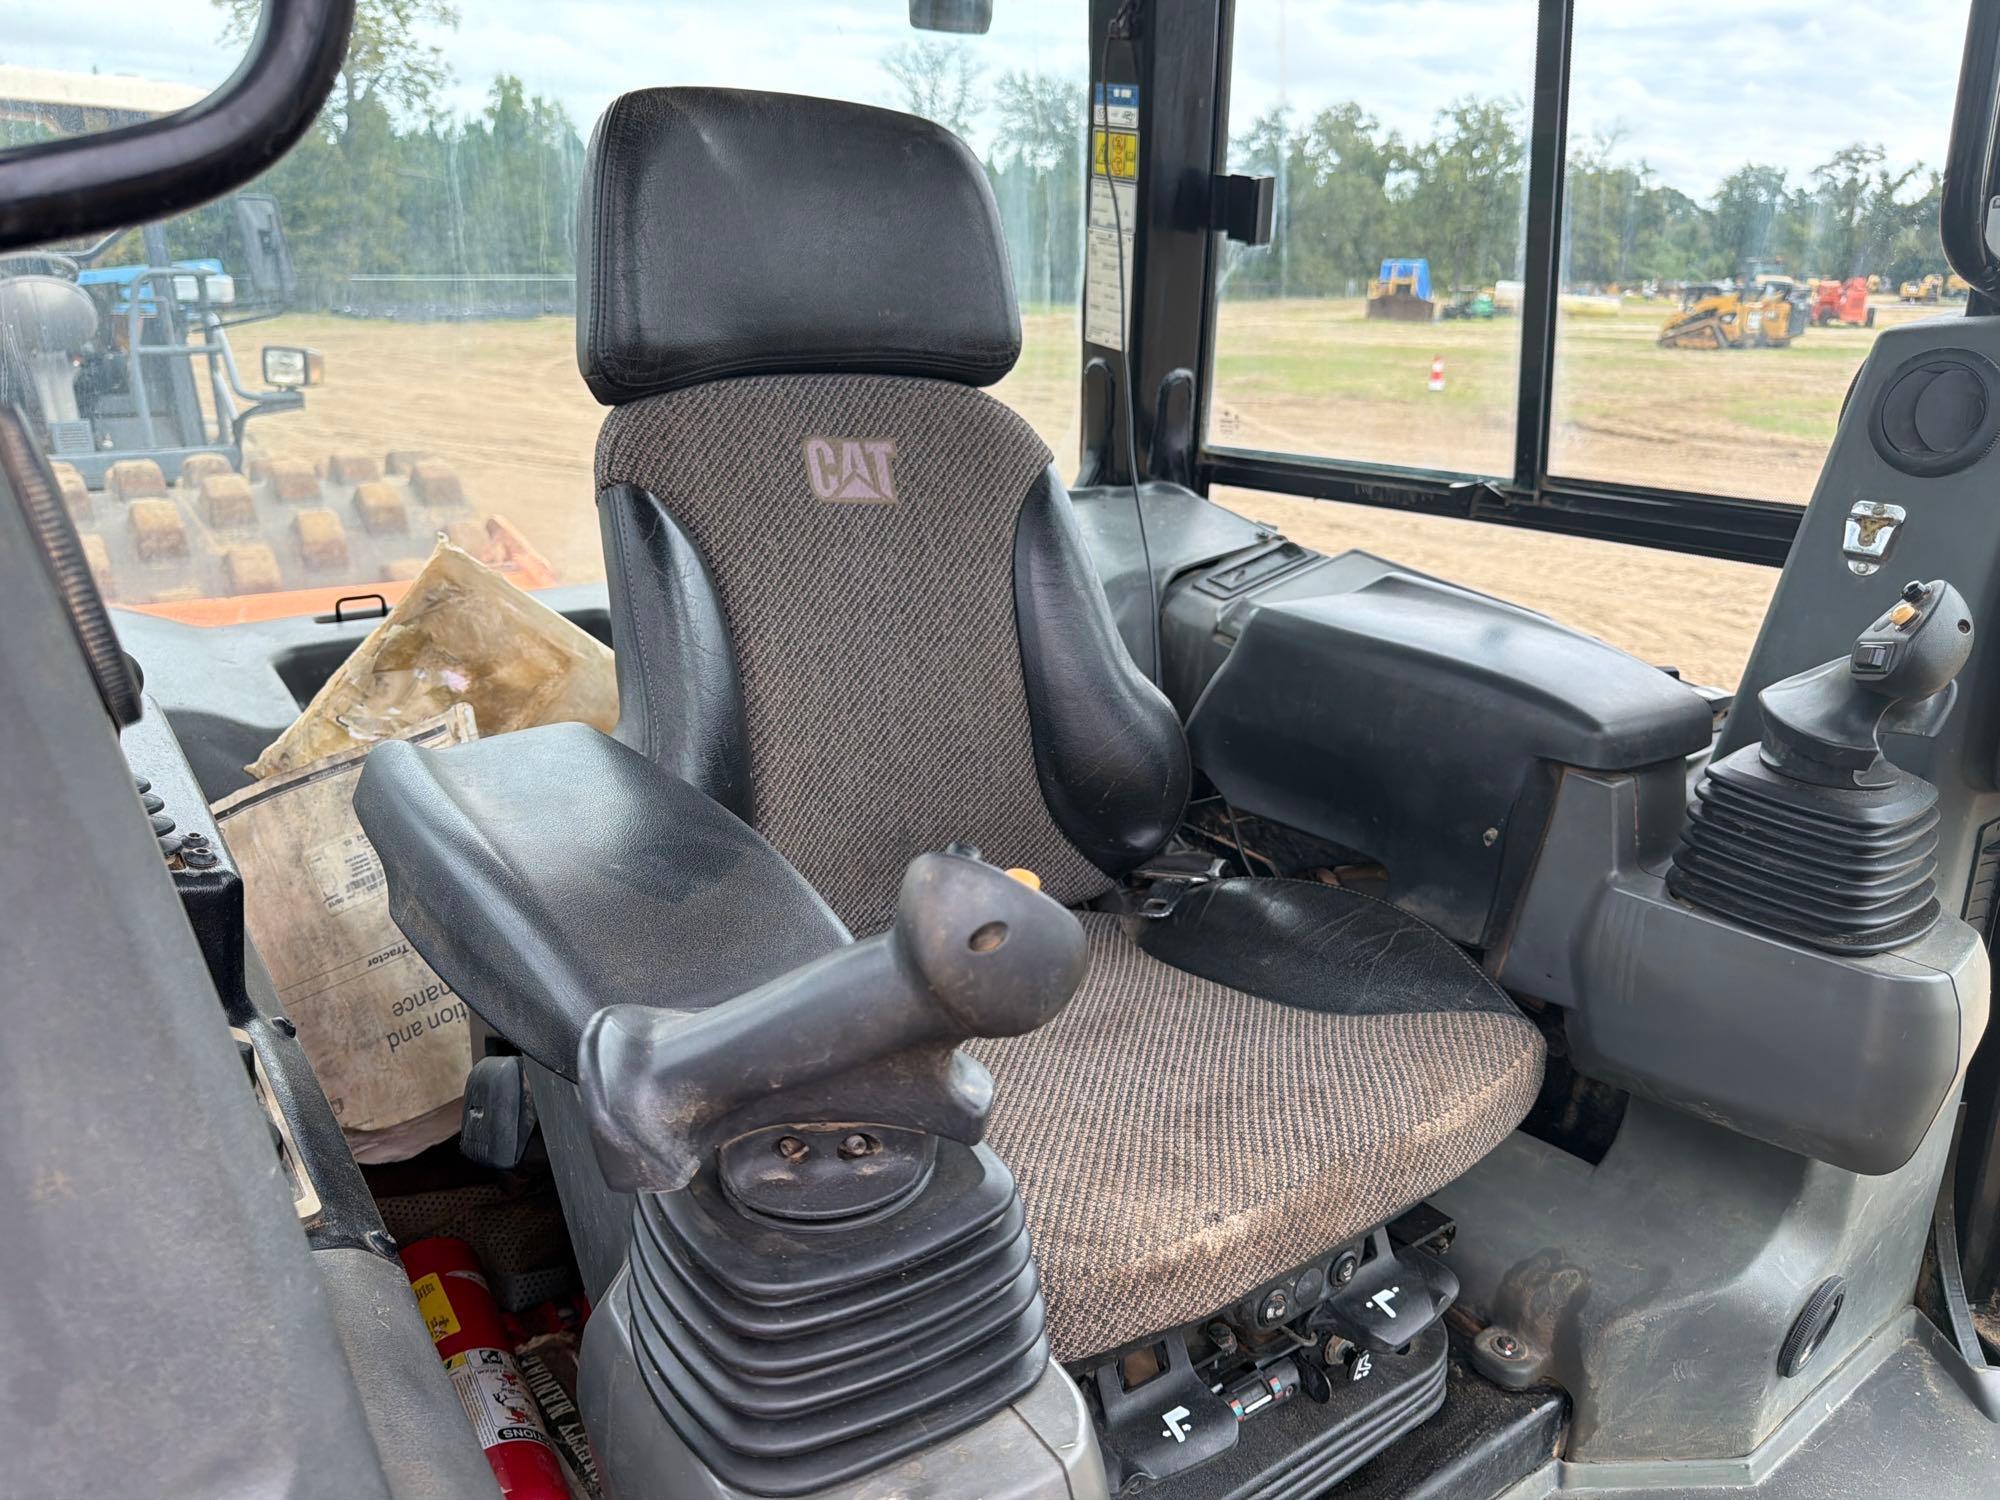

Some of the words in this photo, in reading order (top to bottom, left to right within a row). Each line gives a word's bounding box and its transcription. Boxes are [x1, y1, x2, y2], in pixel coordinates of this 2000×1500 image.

[806, 439, 893, 498] CAT
[367, 944, 409, 967] Tractor
[386, 1021, 424, 1053] and
[520, 1353, 576, 1421] MANUAL
